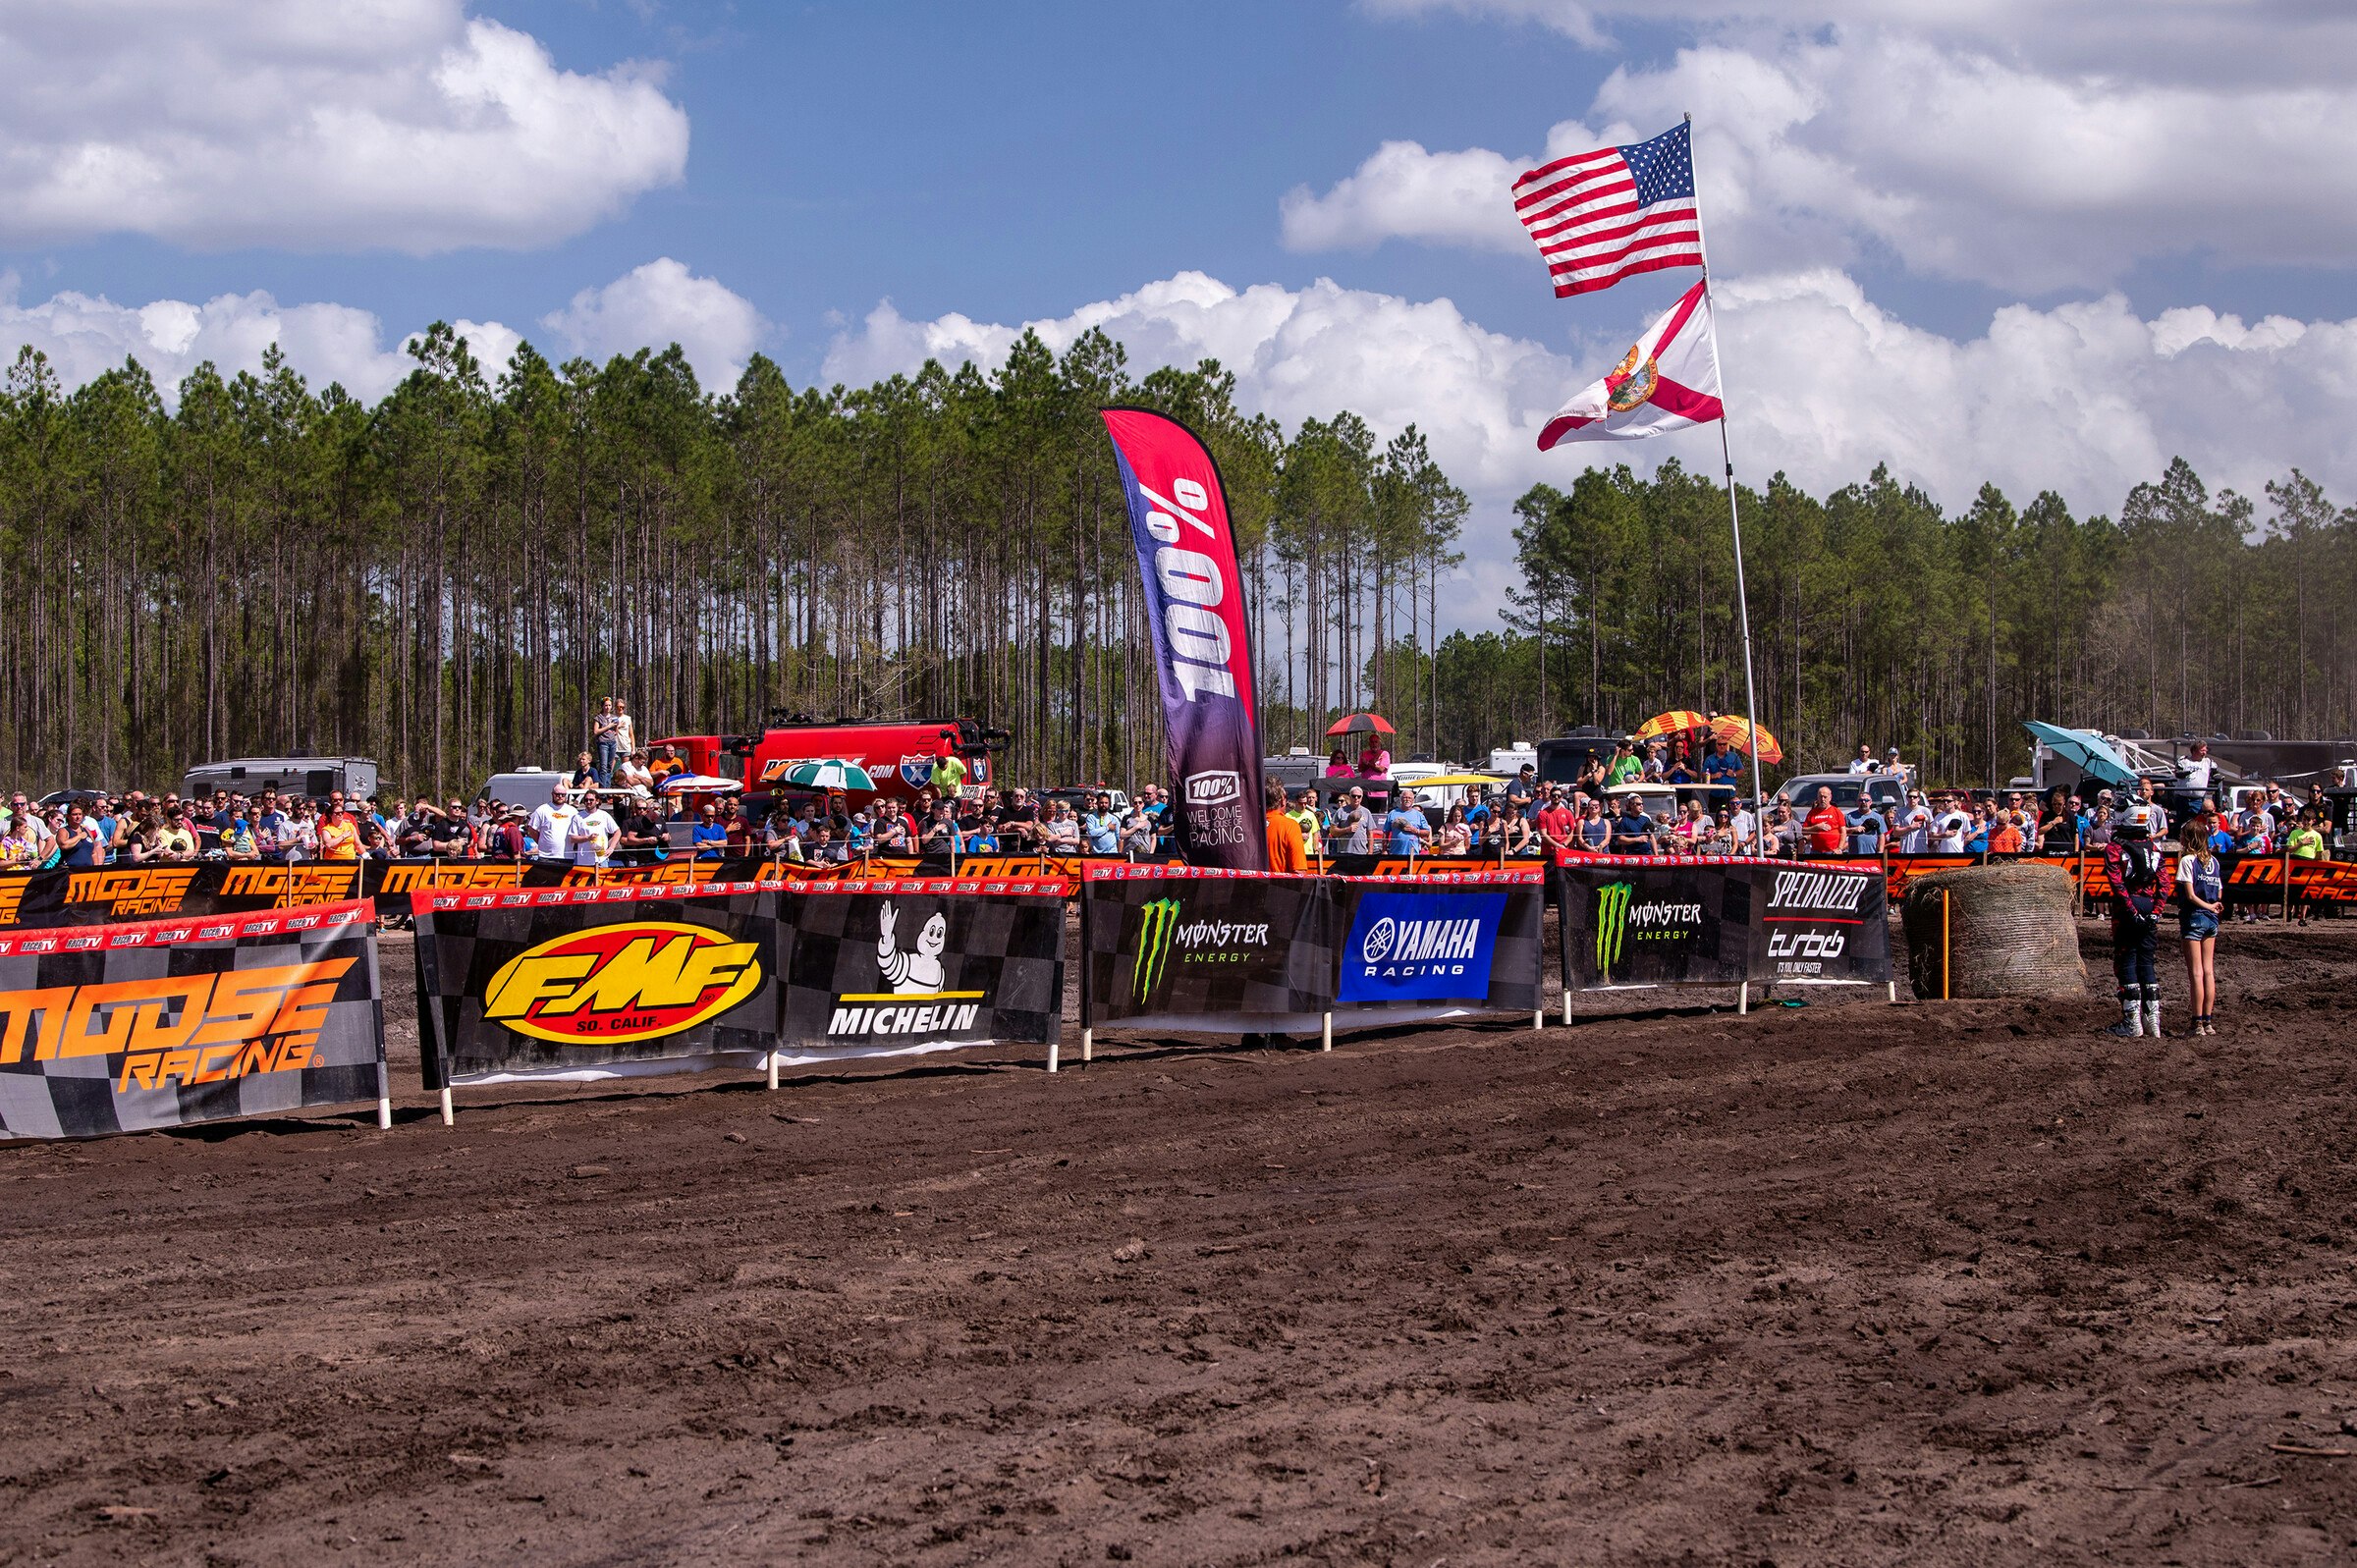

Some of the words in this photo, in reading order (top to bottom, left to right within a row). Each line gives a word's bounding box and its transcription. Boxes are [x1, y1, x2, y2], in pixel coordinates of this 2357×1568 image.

[1139, 477, 1235, 702] 100%
[1193, 777, 1233, 797] 100%
[1186, 805, 1242, 824] WELCOME
[1189, 826, 1244, 848] RACING
[63, 868, 199, 903] MOOSE
[219, 866, 359, 895] MOOSE
[380, 865, 532, 892] MOOSE
[1767, 871, 1869, 910] SPECIALIZED
[110, 896, 184, 916] RACING
[1392, 918, 1479, 961] YAMAHA
[1637, 930, 1689, 941] ENERGY
[1768, 928, 1844, 957] turbo
[1184, 951, 1250, 963] ENERGY
[1364, 963, 1465, 977] RACING
[484, 934, 759, 1018] FMF
[0, 956, 358, 1063] MOOSE
[576, 1017, 603, 1032] SO.
[611, 1015, 662, 1030] CALIF.
[827, 1003, 979, 1035] MICHELIN
[118, 1032, 321, 1094] RACING
